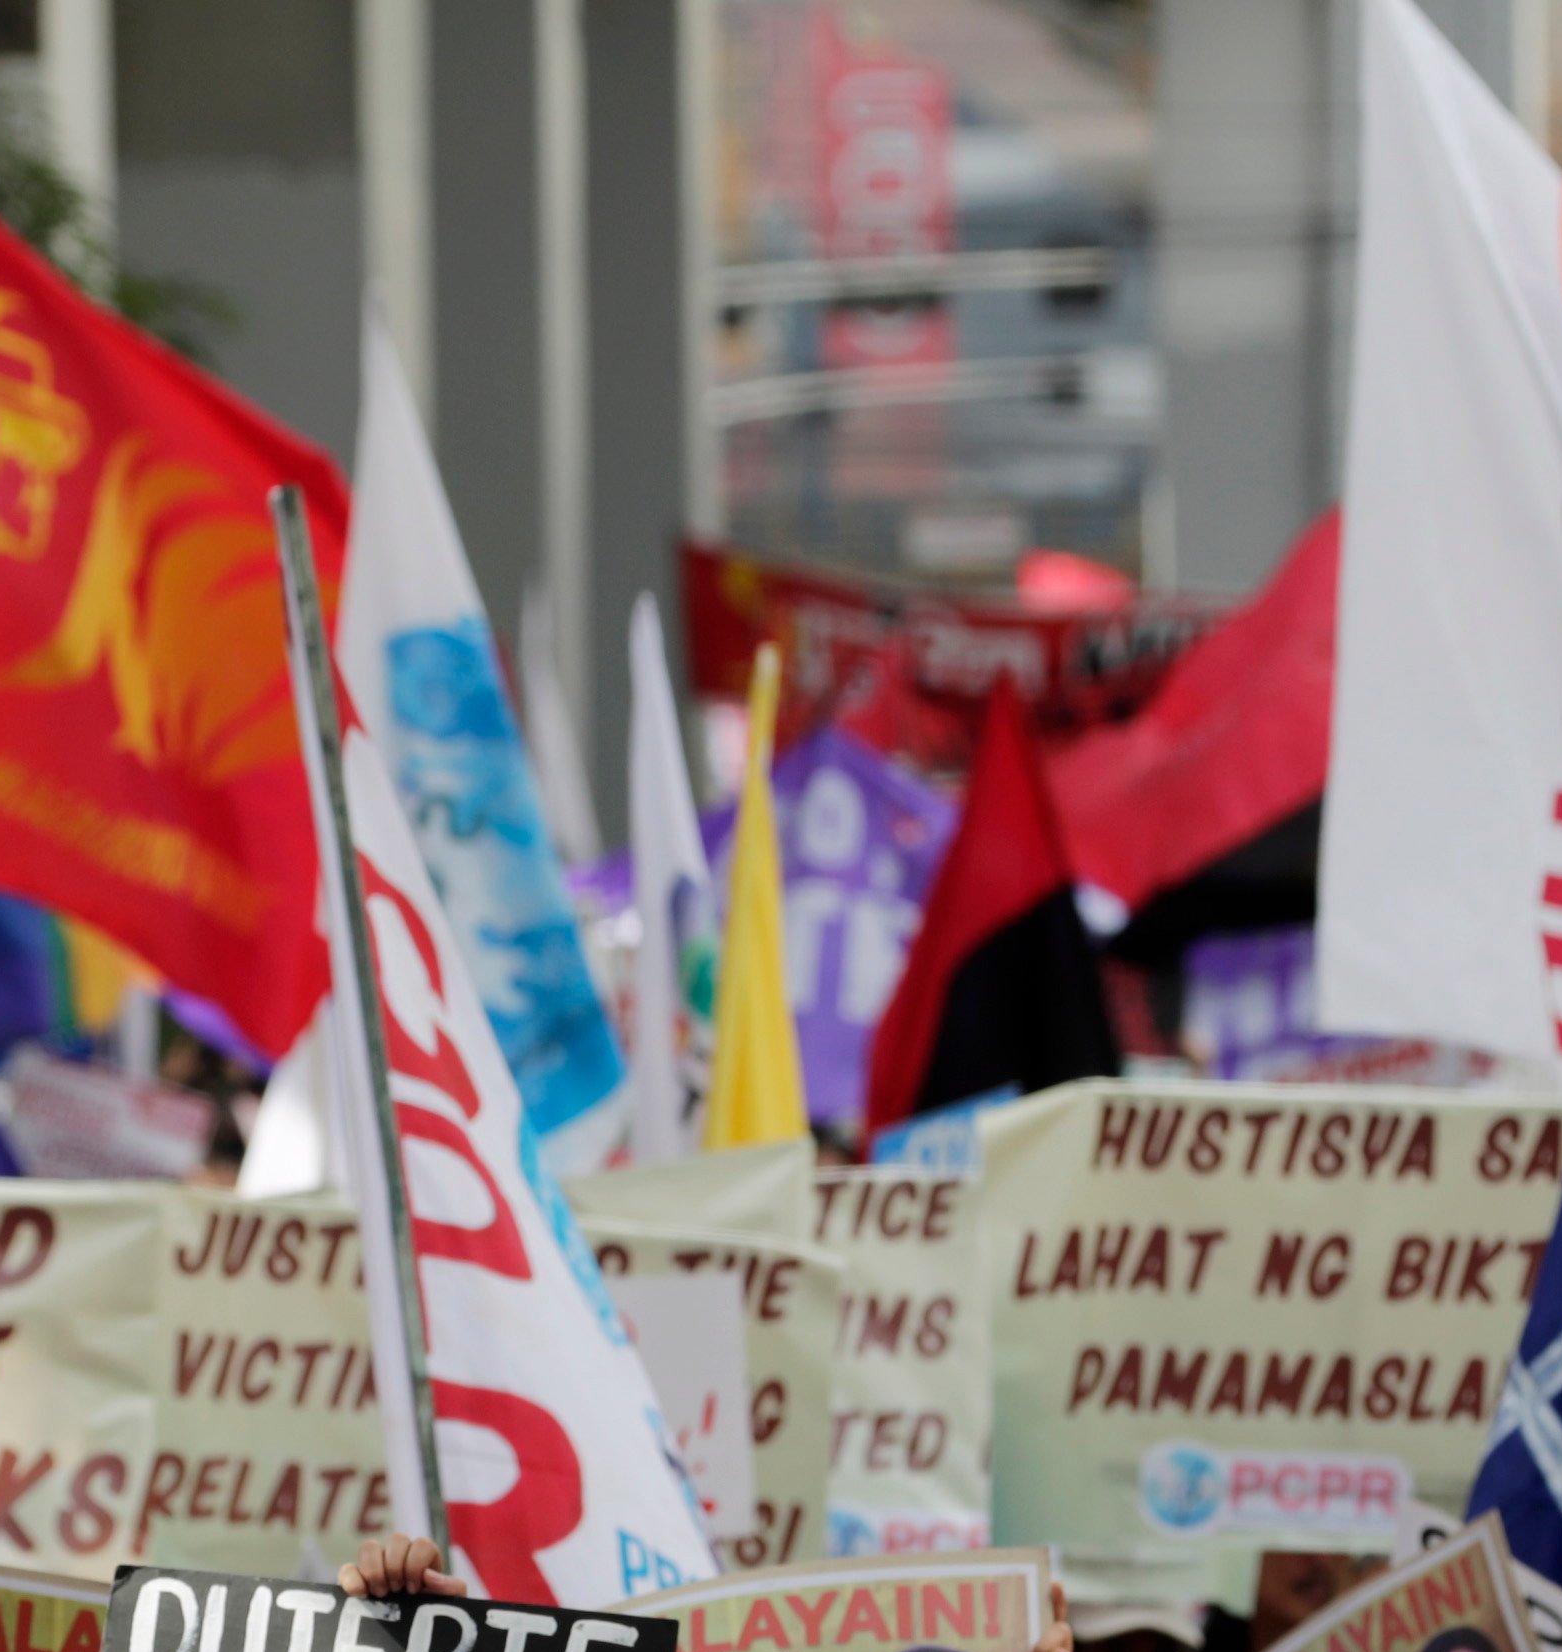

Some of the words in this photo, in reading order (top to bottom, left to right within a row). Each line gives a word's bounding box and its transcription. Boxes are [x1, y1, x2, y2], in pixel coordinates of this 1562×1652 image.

[1094, 1104, 1439, 1181] HUSTISYA
[1012, 1226, 1225, 1300] LAHAT
[1256, 1236, 1352, 1298] NG
[1385, 1237, 1544, 1306] BIKT
[1065, 1345, 1504, 1424] PAMAMASLA
[1228, 1460, 1397, 1513] PCPR
